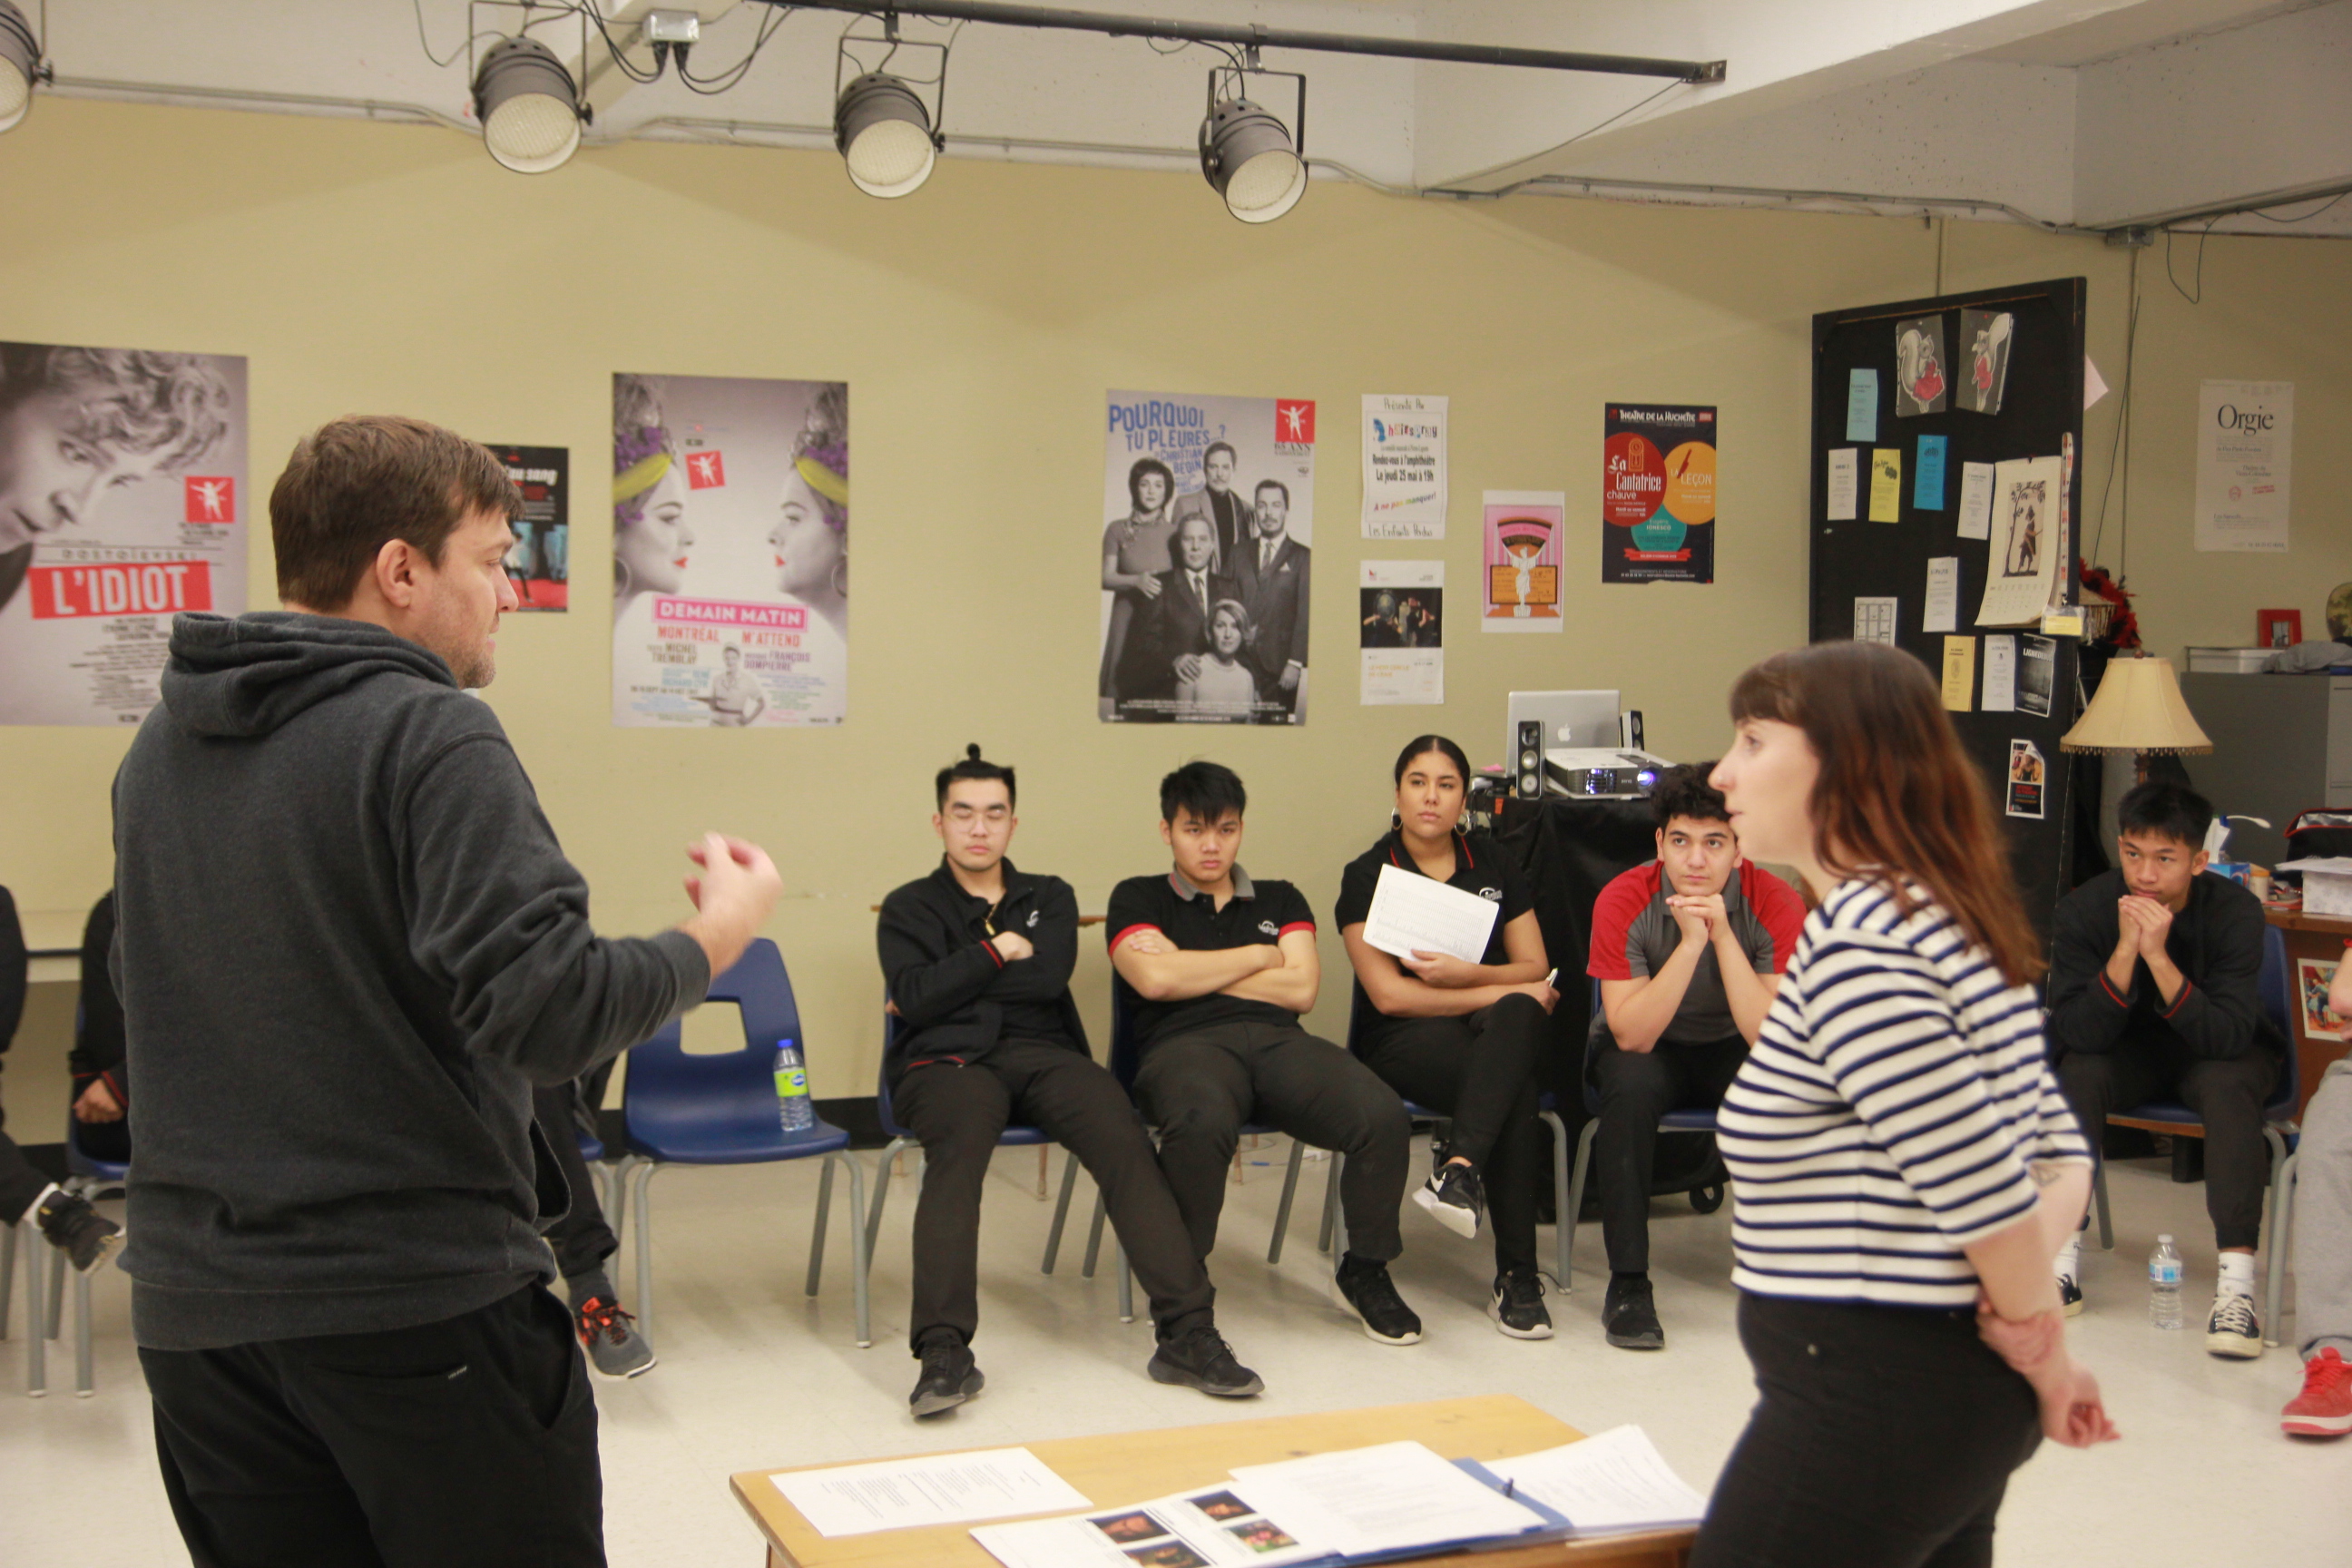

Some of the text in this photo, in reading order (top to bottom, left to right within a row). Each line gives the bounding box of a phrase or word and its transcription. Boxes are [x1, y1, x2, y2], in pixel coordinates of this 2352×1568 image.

[1109, 400, 1204, 433] POURQUOI
[2217, 404, 2274, 436] Orgie
[1125, 431, 1144, 452] TU
[1607, 455, 1627, 475] La
[525, 467, 558, 486] sang
[1376, 468, 1384, 481] Le
[1385, 468, 1398, 485] jeudi
[1399, 468, 1406, 481] 25
[1406, 469, 1417, 481] mai
[1616, 471, 1661, 492] Cantatrice
[1681, 473, 1712, 487] LEÇON
[1606, 489, 1637, 500] chauve
[1390, 500, 1404, 510] pas
[51, 564, 189, 615] L'IDIOT
[660, 601, 737, 622] DEMAIN
[740, 606, 802, 626] MATIN
[657, 624, 721, 643] MONTRÉAL
[741, 631, 801, 648] M'ATTEND
[652, 653, 697, 664] TREMBLAY
